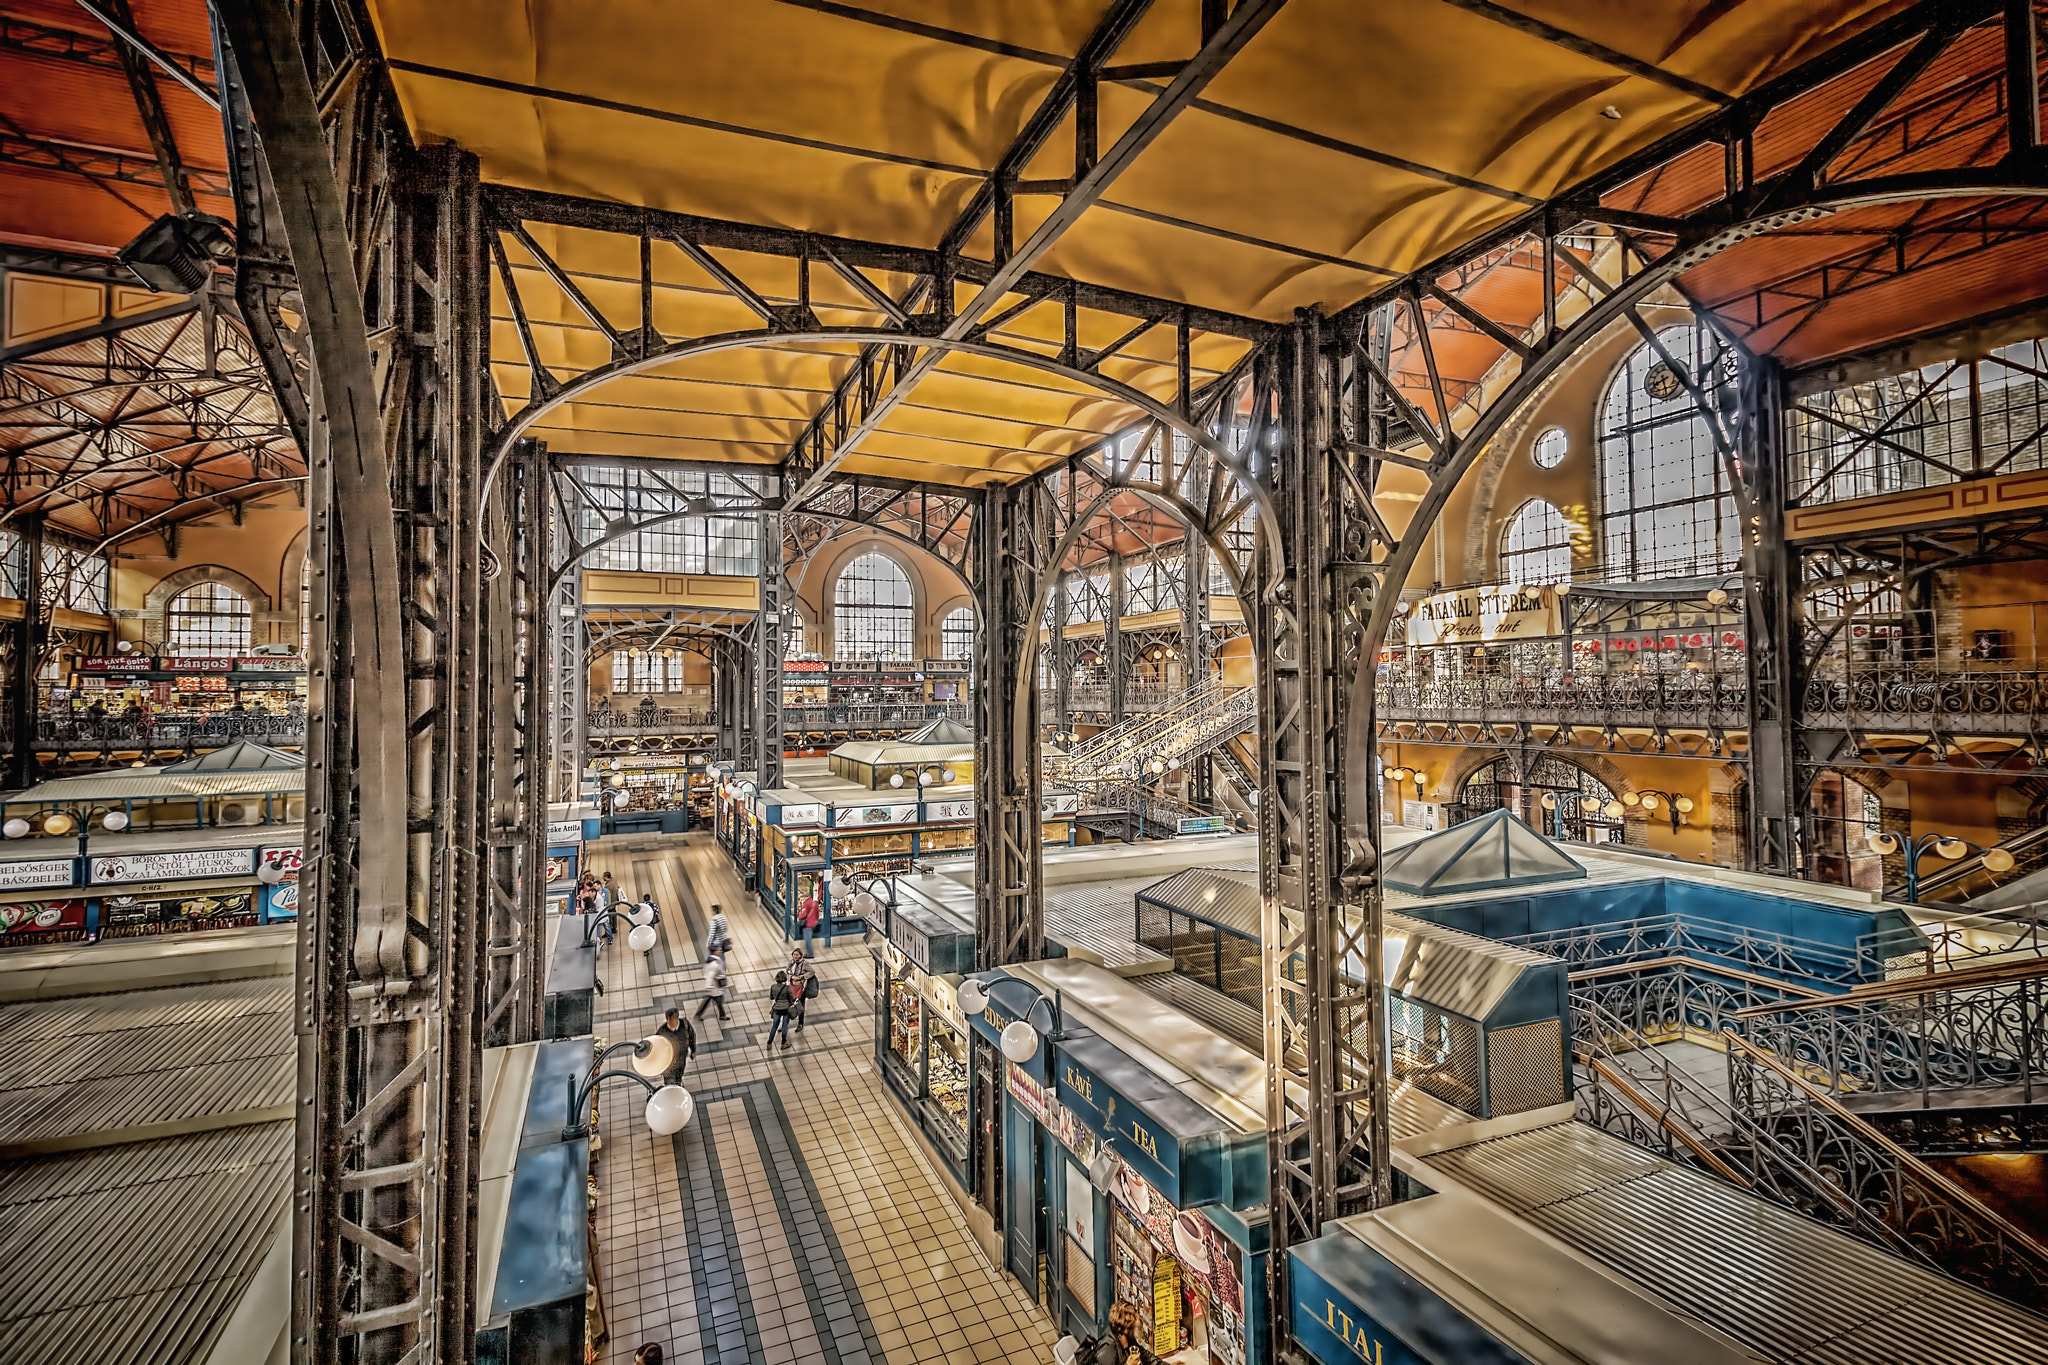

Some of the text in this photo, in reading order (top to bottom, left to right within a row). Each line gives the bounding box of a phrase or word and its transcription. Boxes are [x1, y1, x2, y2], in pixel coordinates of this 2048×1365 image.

[1421, 590, 1542, 621] FAKANÁL ÉTTEREM
[1440, 619, 1521, 638] Restaant
[104, 657, 125, 665] KÁVÉ
[957, 803, 969, 816] &
[563, 824, 580, 832] Attila
[172, 850, 248, 862] MALACHUSOK
[198, 858, 233, 868] HUSOK
[188, 864, 252, 876] KOLBÁSZOK
[0, 873, 69, 885] BÁSZBELEK
[1066, 1065, 1094, 1102] KÁVÉ
[1131, 1120, 1159, 1160] TEA
